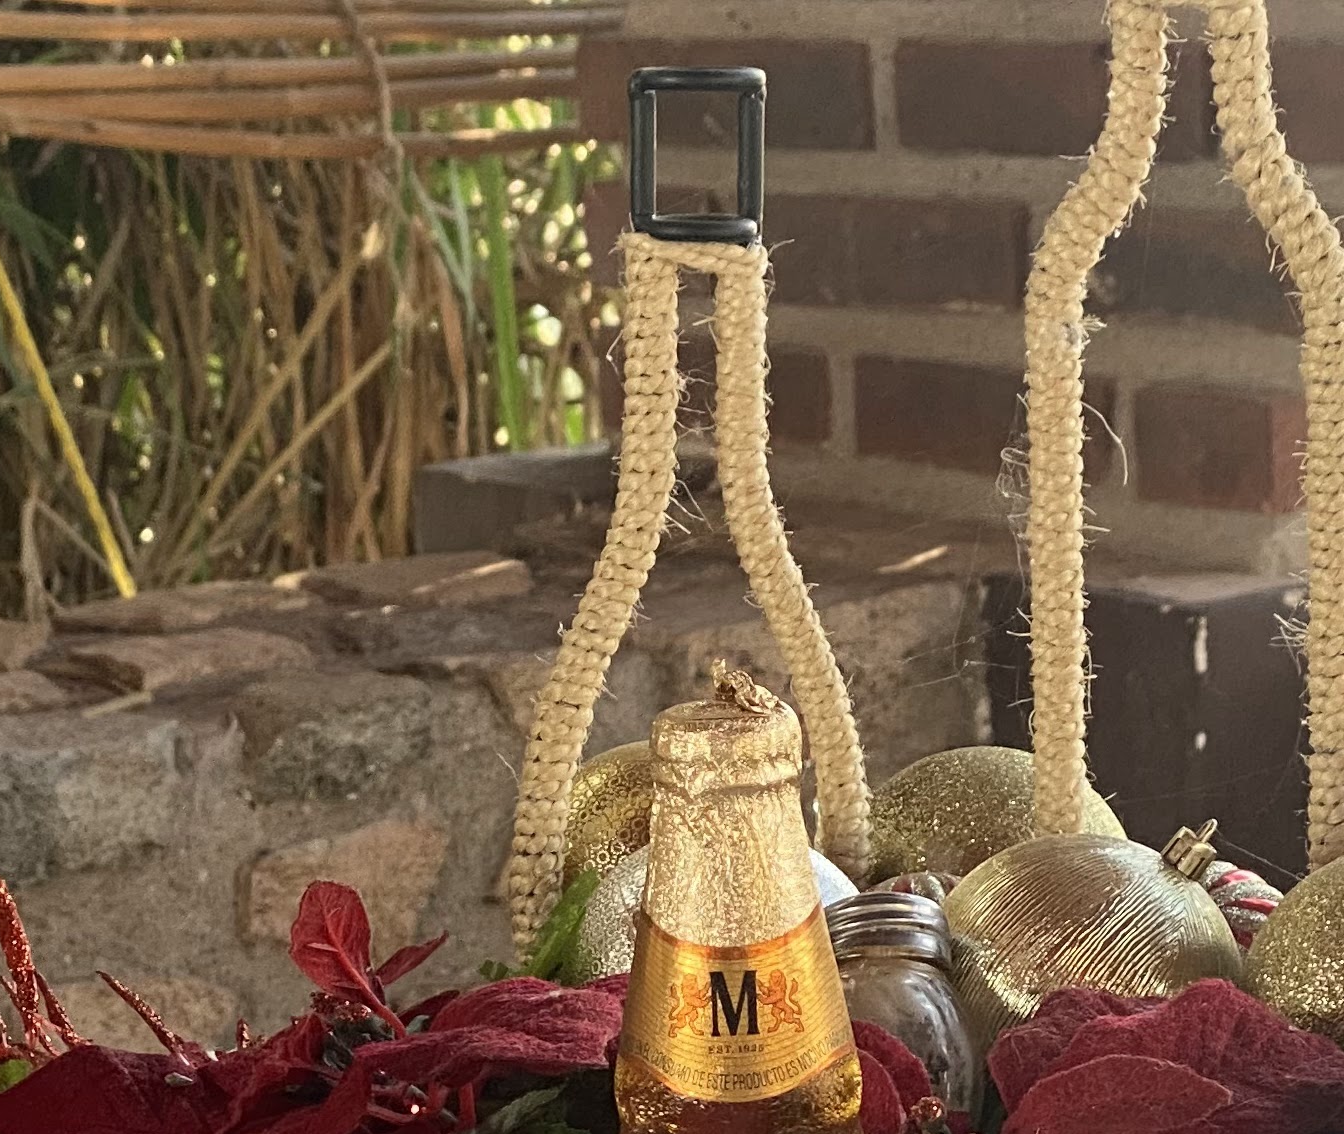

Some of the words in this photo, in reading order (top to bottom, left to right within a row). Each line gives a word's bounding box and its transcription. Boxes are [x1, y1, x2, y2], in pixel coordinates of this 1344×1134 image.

[709, 969, 760, 1037] M
[692, 1069, 706, 1088] DE
[706, 1072, 730, 1091] ESTE
[732, 1062, 786, 1092] PRODUCTO
[784, 1059, 800, 1078] ES
